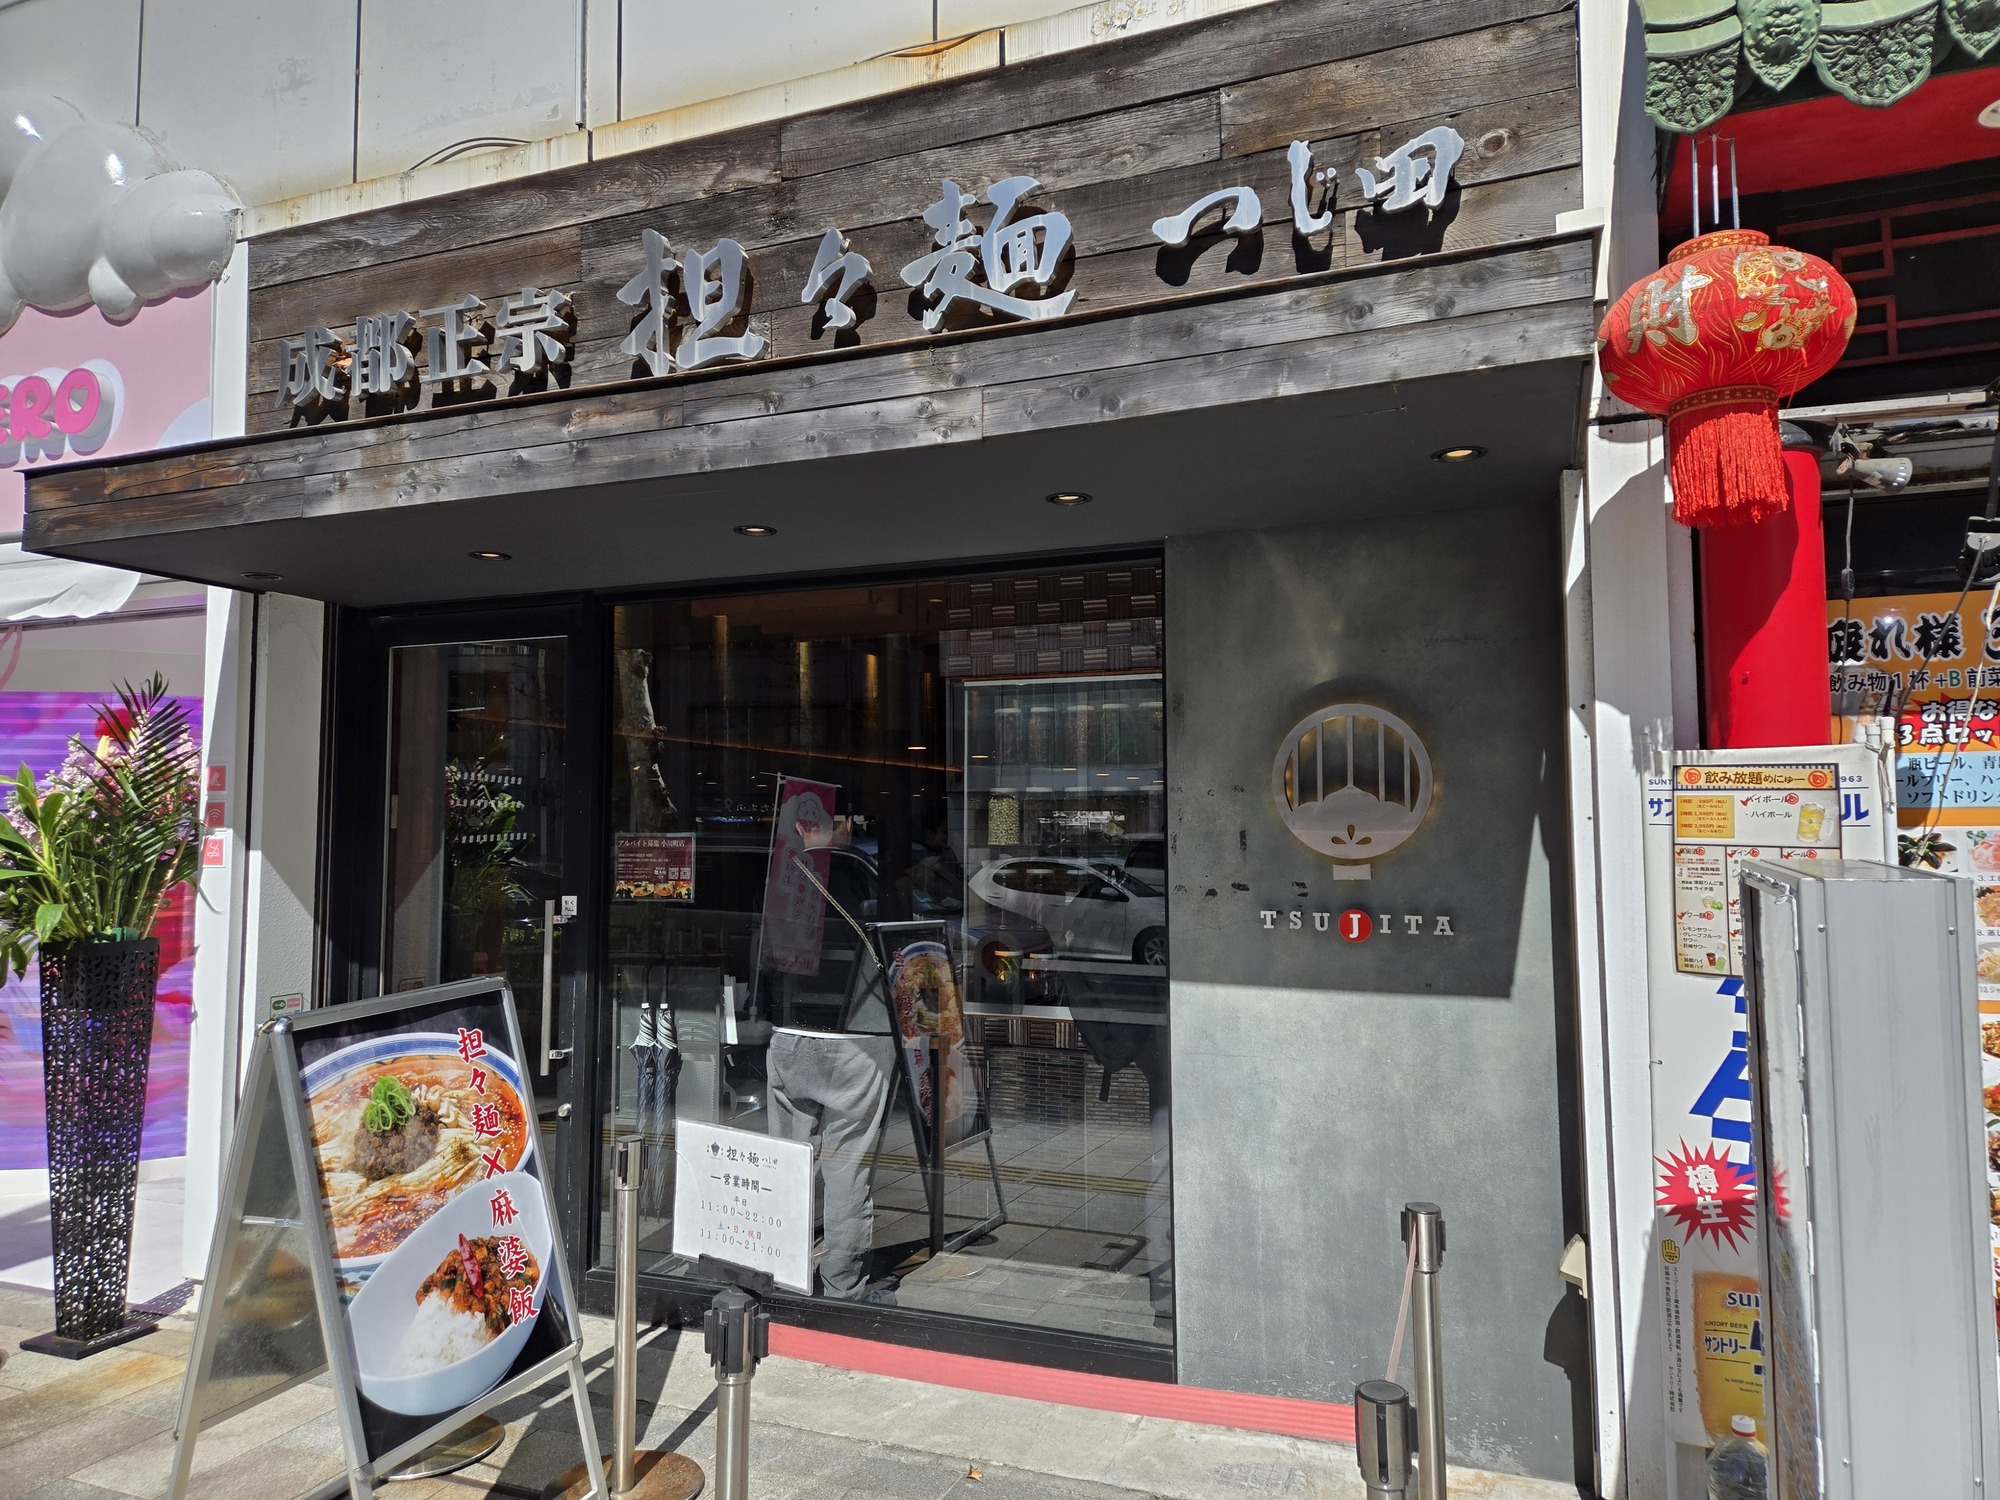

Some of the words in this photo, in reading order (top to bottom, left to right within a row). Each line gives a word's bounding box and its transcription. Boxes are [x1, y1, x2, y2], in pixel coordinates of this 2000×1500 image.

[276, 287, 571, 409] 成都正宗
[619, 174, 1077, 376] 担々麺
[1150, 124, 1466, 249] つじ田
[0, 368, 100, 444] RO
[1921, 700, 1998, 722] お得な
[1704, 770, 1806, 785] 飲み放題めにゅー
[1750, 810, 1793, 819] ハイボール
[1260, 910, 1454, 938] TSUJITA
[726, 1145, 759, 1168] 担々麺
[733, 1195, 747, 1207] 平日
[1685, 1164, 1730, 1224] 樽生
[1704, 1335, 1747, 1355] サントリー
